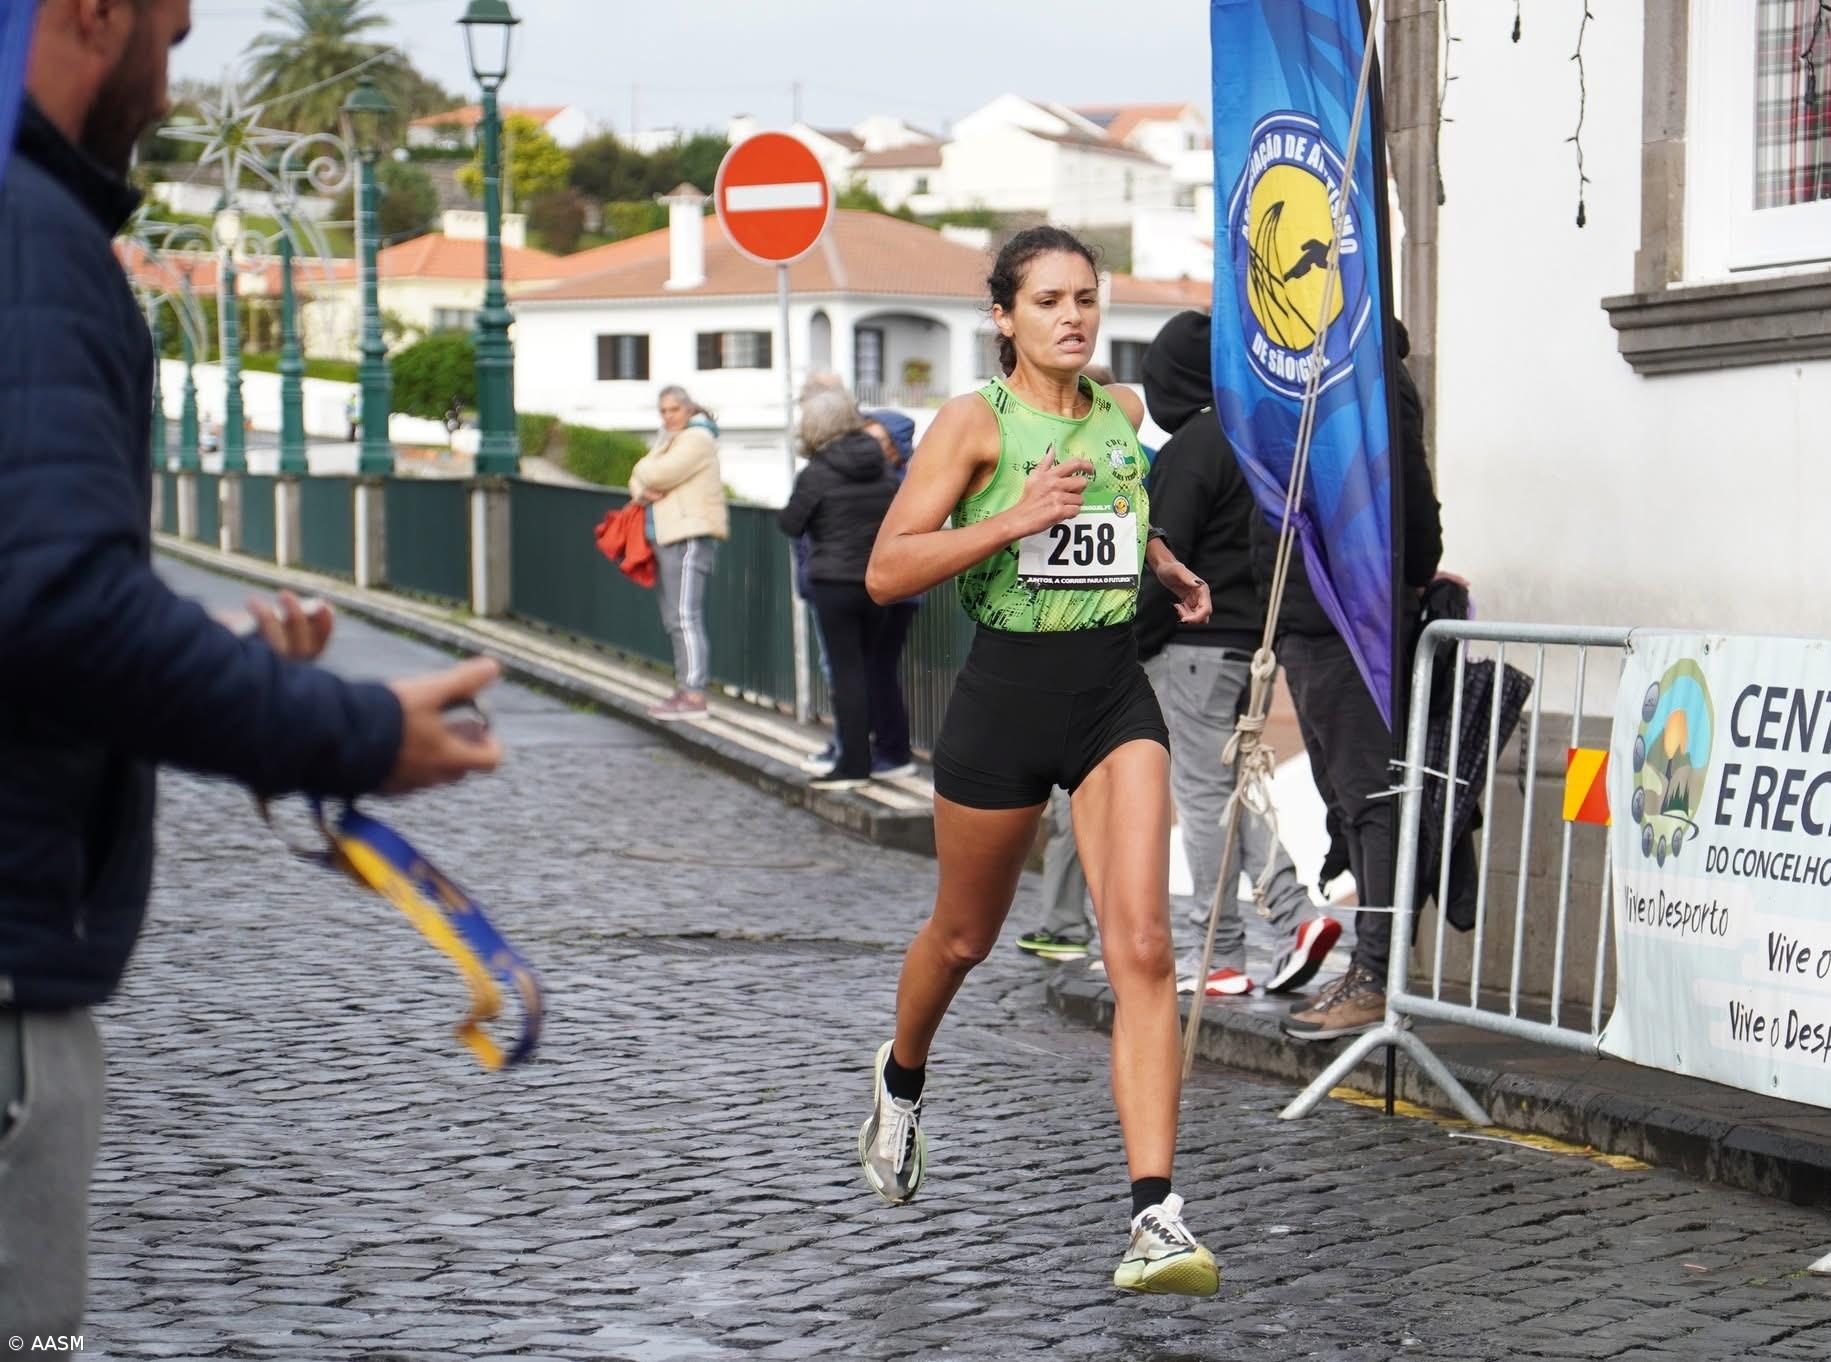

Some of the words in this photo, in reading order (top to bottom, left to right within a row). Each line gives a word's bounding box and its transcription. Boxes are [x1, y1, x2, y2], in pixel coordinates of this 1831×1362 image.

[1285, 134, 1307, 161] DE
[1251, 331, 1269, 364] DE
[1268, 349, 1296, 381] SÃO
[1047, 522, 1115, 566] 258
[1714, 763, 1742, 826] E
[1743, 765, 1831, 836] REC
[1706, 845, 1729, 874] DO
[1732, 848, 1831, 887] CONCELHO
[1648, 897, 1655, 926] o
[1659, 889, 1729, 936] Desporto
[1768, 931, 1811, 974] Vive
[1817, 949, 1831, 979] o
[1729, 1000, 1766, 1042] Vive
[1771, 1018, 1780, 1047] o
